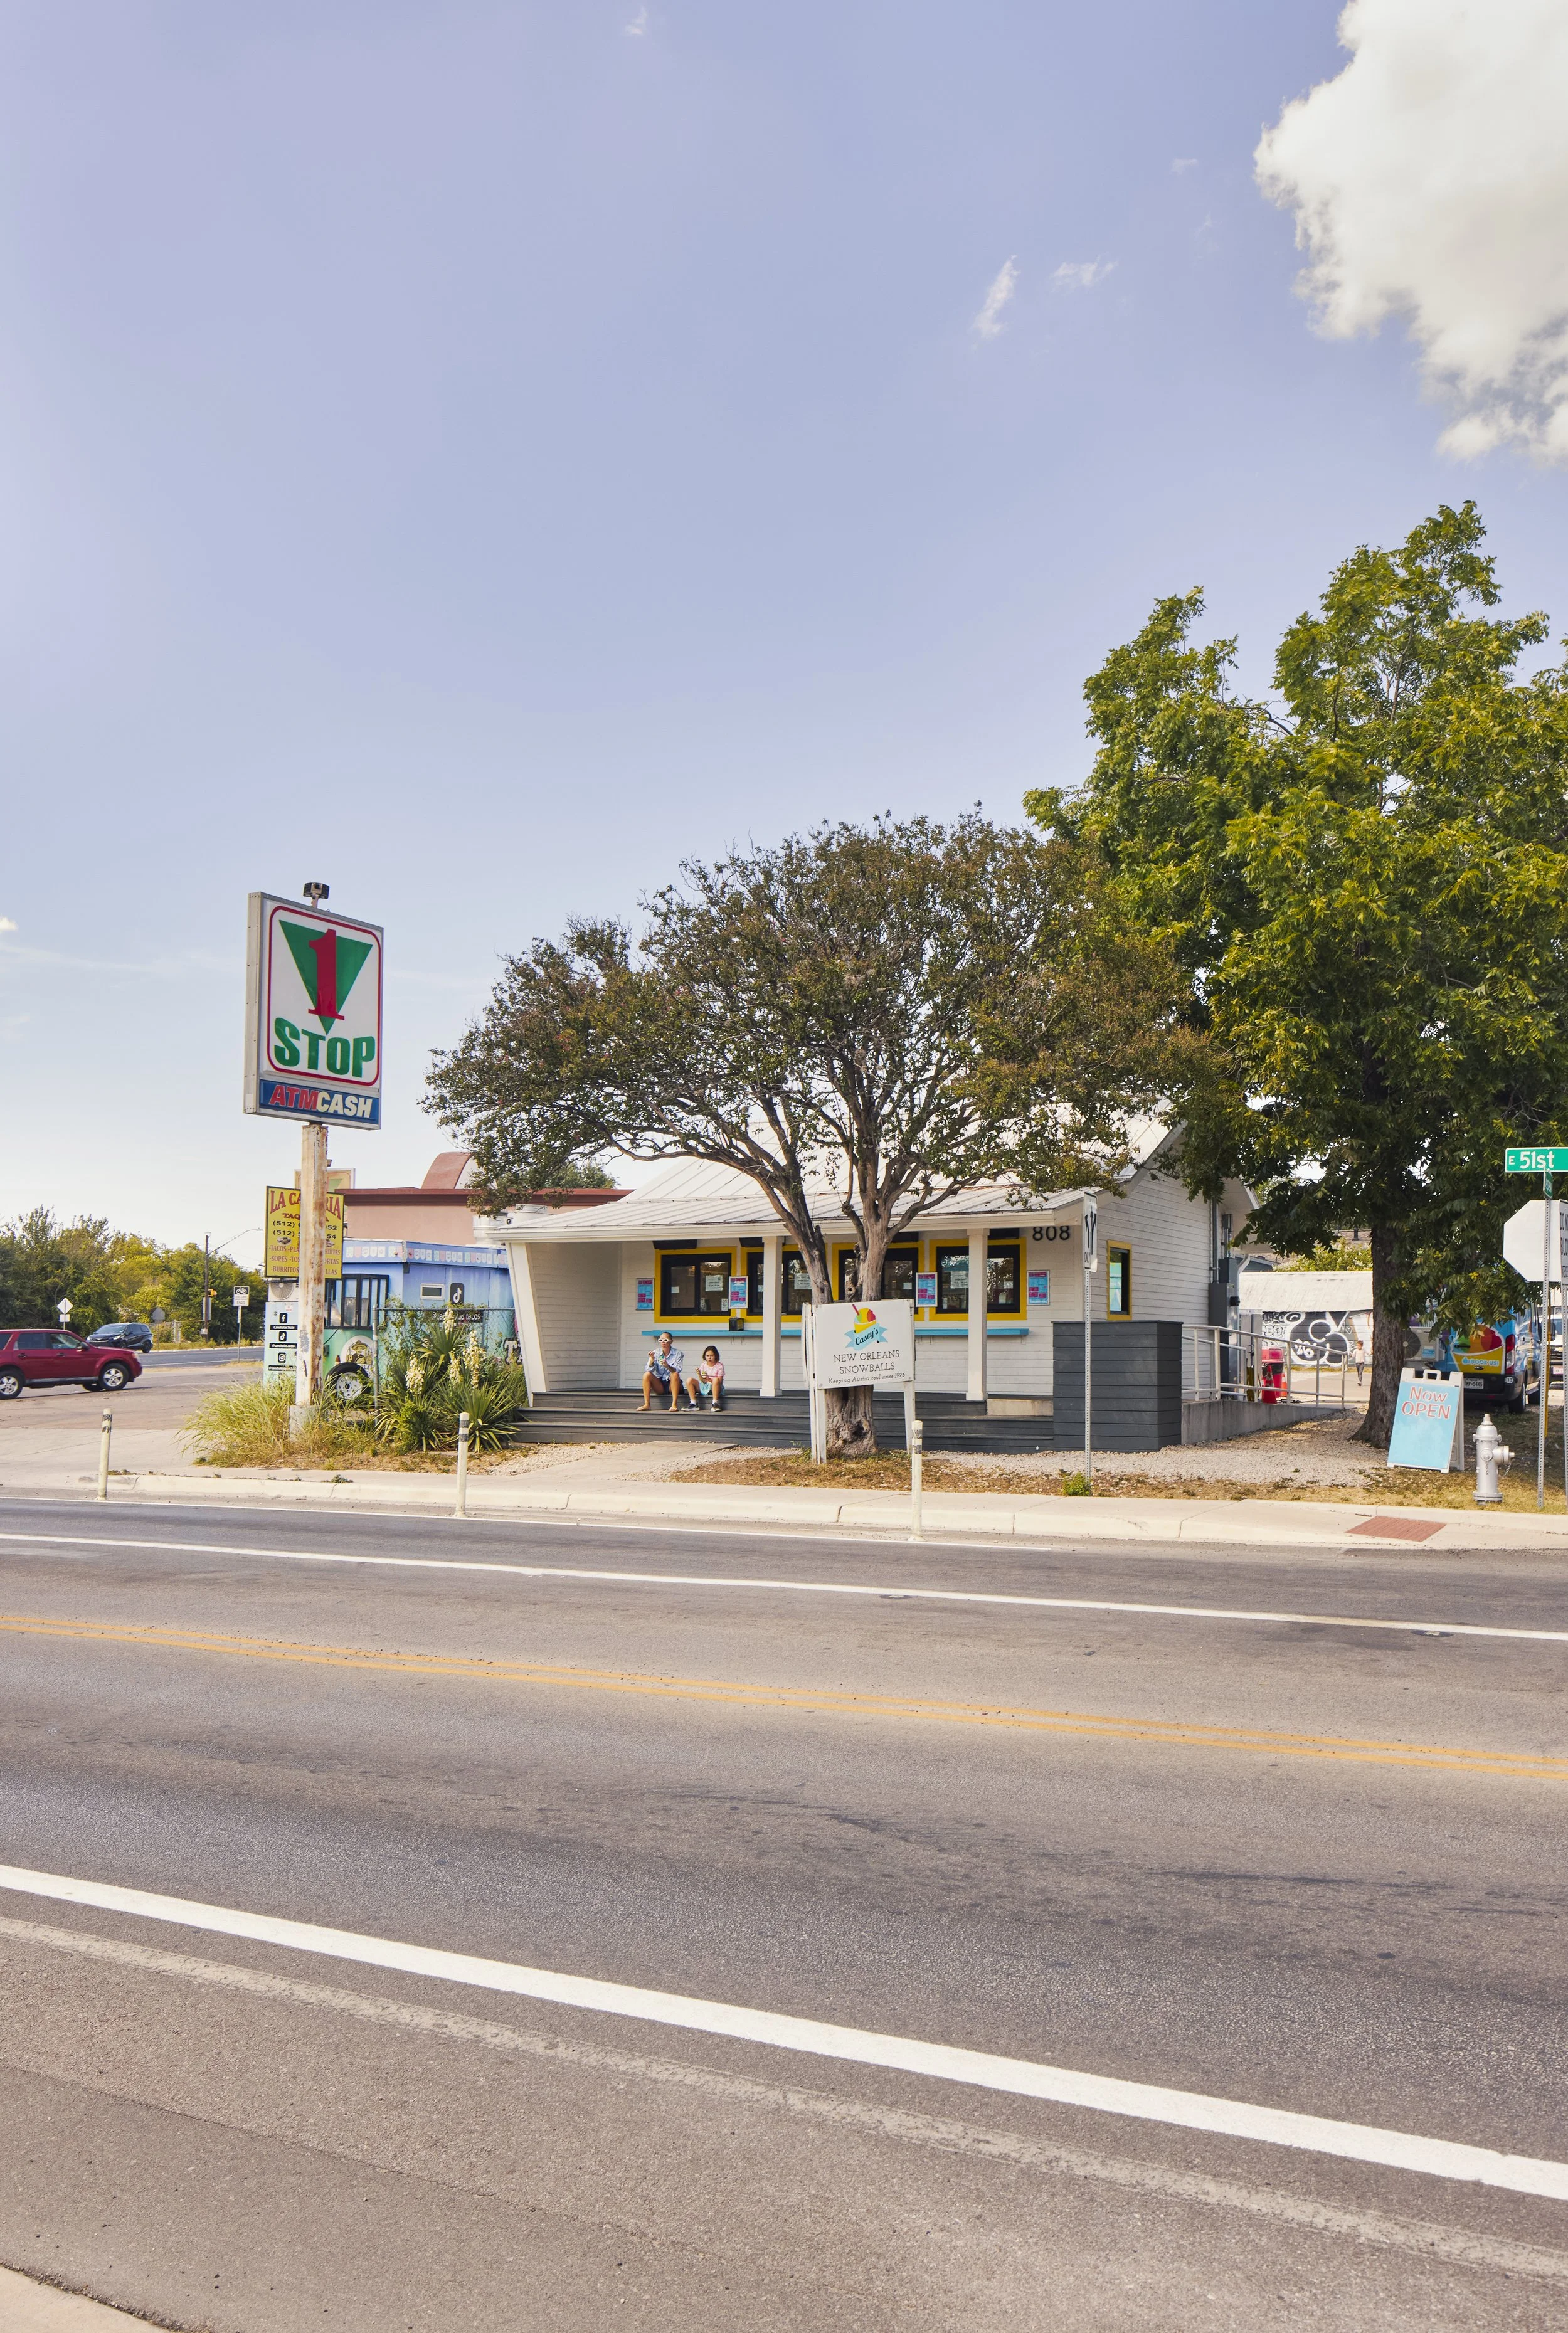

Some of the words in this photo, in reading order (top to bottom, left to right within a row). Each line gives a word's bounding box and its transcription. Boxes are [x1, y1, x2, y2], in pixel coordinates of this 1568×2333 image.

[308, 928, 345, 1021] 1
[273, 1017, 376, 1078] STOP
[1508, 1155, 1515, 1165] E
[1519, 1151, 1555, 1169] 51st
[270, 1190, 287, 1214] LA
[282, 1212, 300, 1220] TAQ
[1032, 1225, 1070, 1241] 808
[855, 1327, 879, 1345] Casey's
[834, 1353, 857, 1363] NEW
[859, 1350, 900, 1361] ORLEANS
[839, 1362, 895, 1375] SNOWBALLS
[1401, 1400, 1451, 1420] OPEN
